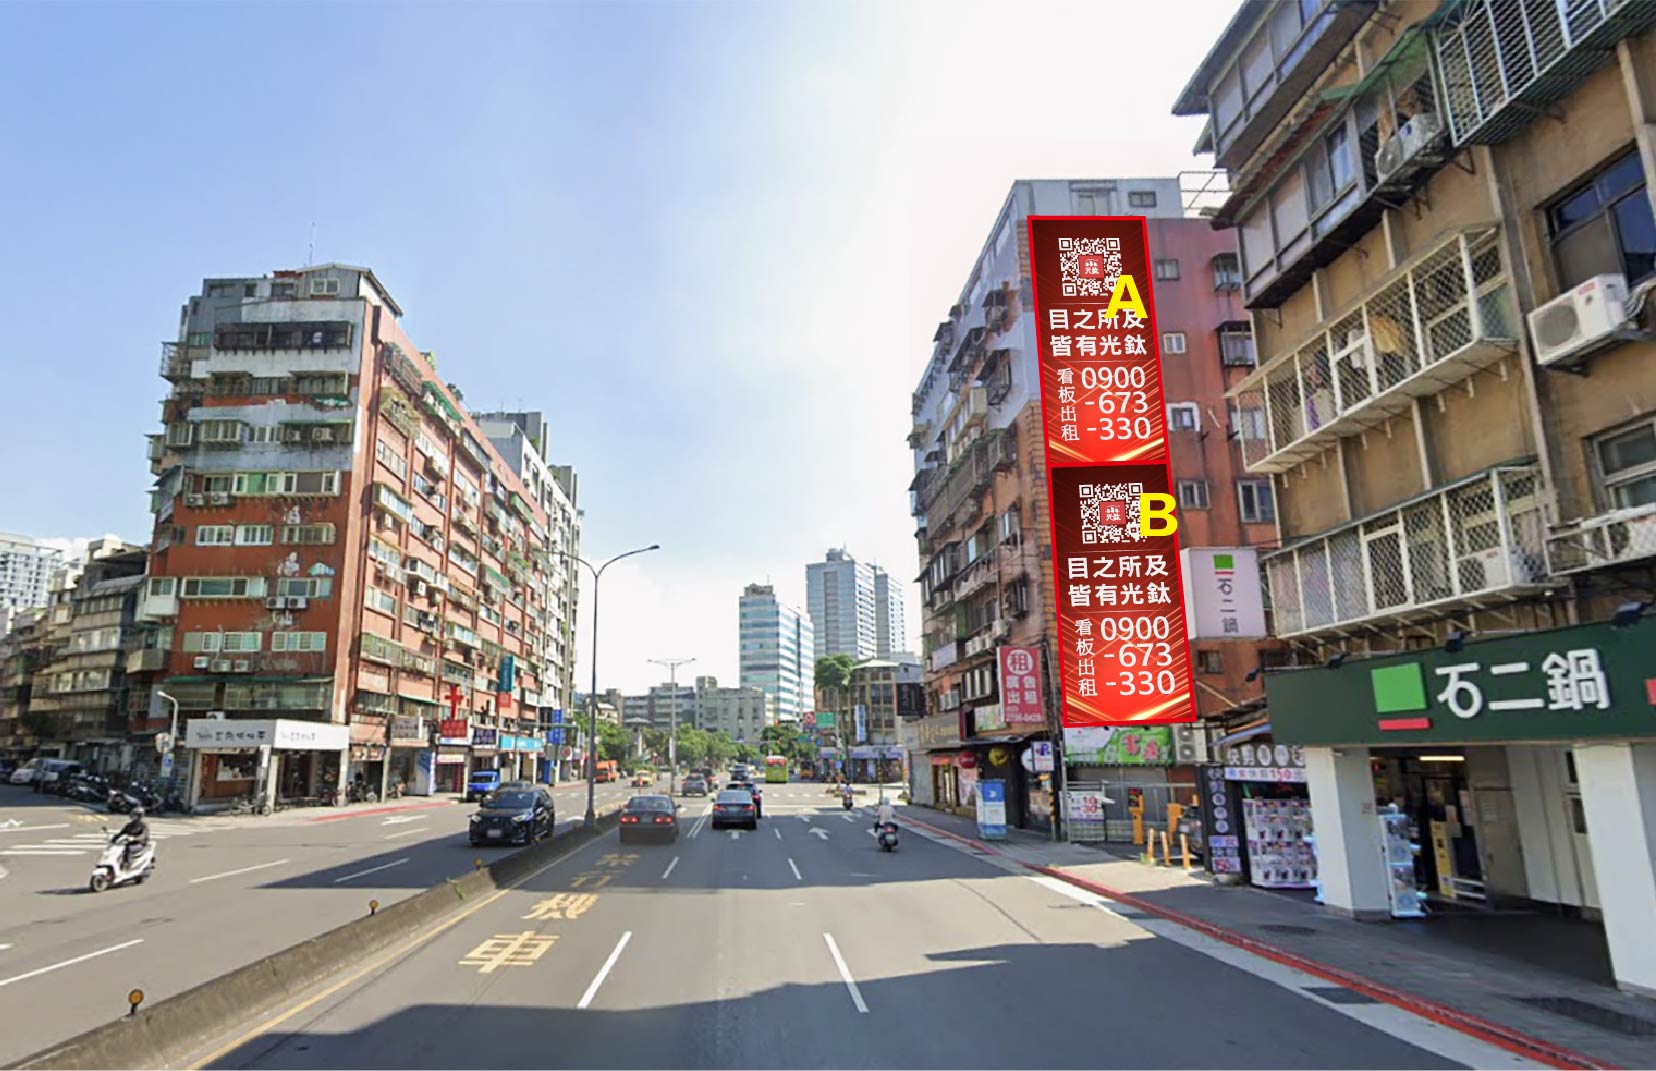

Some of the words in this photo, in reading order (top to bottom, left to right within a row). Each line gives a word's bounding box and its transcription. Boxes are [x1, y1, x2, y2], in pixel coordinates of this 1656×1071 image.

[1049, 309, 1144, 330] 目之所及
[1050, 335, 1147, 357] 皆有光鈦
[1081, 366, 1146, 390] 0900
[1057, 367, 1080, 442] 看板出租
[1085, 391, 1149, 415] -673
[1086, 417, 1151, 441] -330
[1067, 554, 1169, 579] 目之所及
[1068, 581, 1171, 607] 皆有光鈦
[1217, 578, 1240, 634] 石二鍋
[1100, 616, 1170, 641] 0900
[1009, 653, 1030, 671] 租
[1074, 618, 1098, 697] 看板出租
[1104, 642, 1173, 667] -673
[1106, 670, 1176, 696] -330
[1434, 648, 1612, 719] 石二鍋
